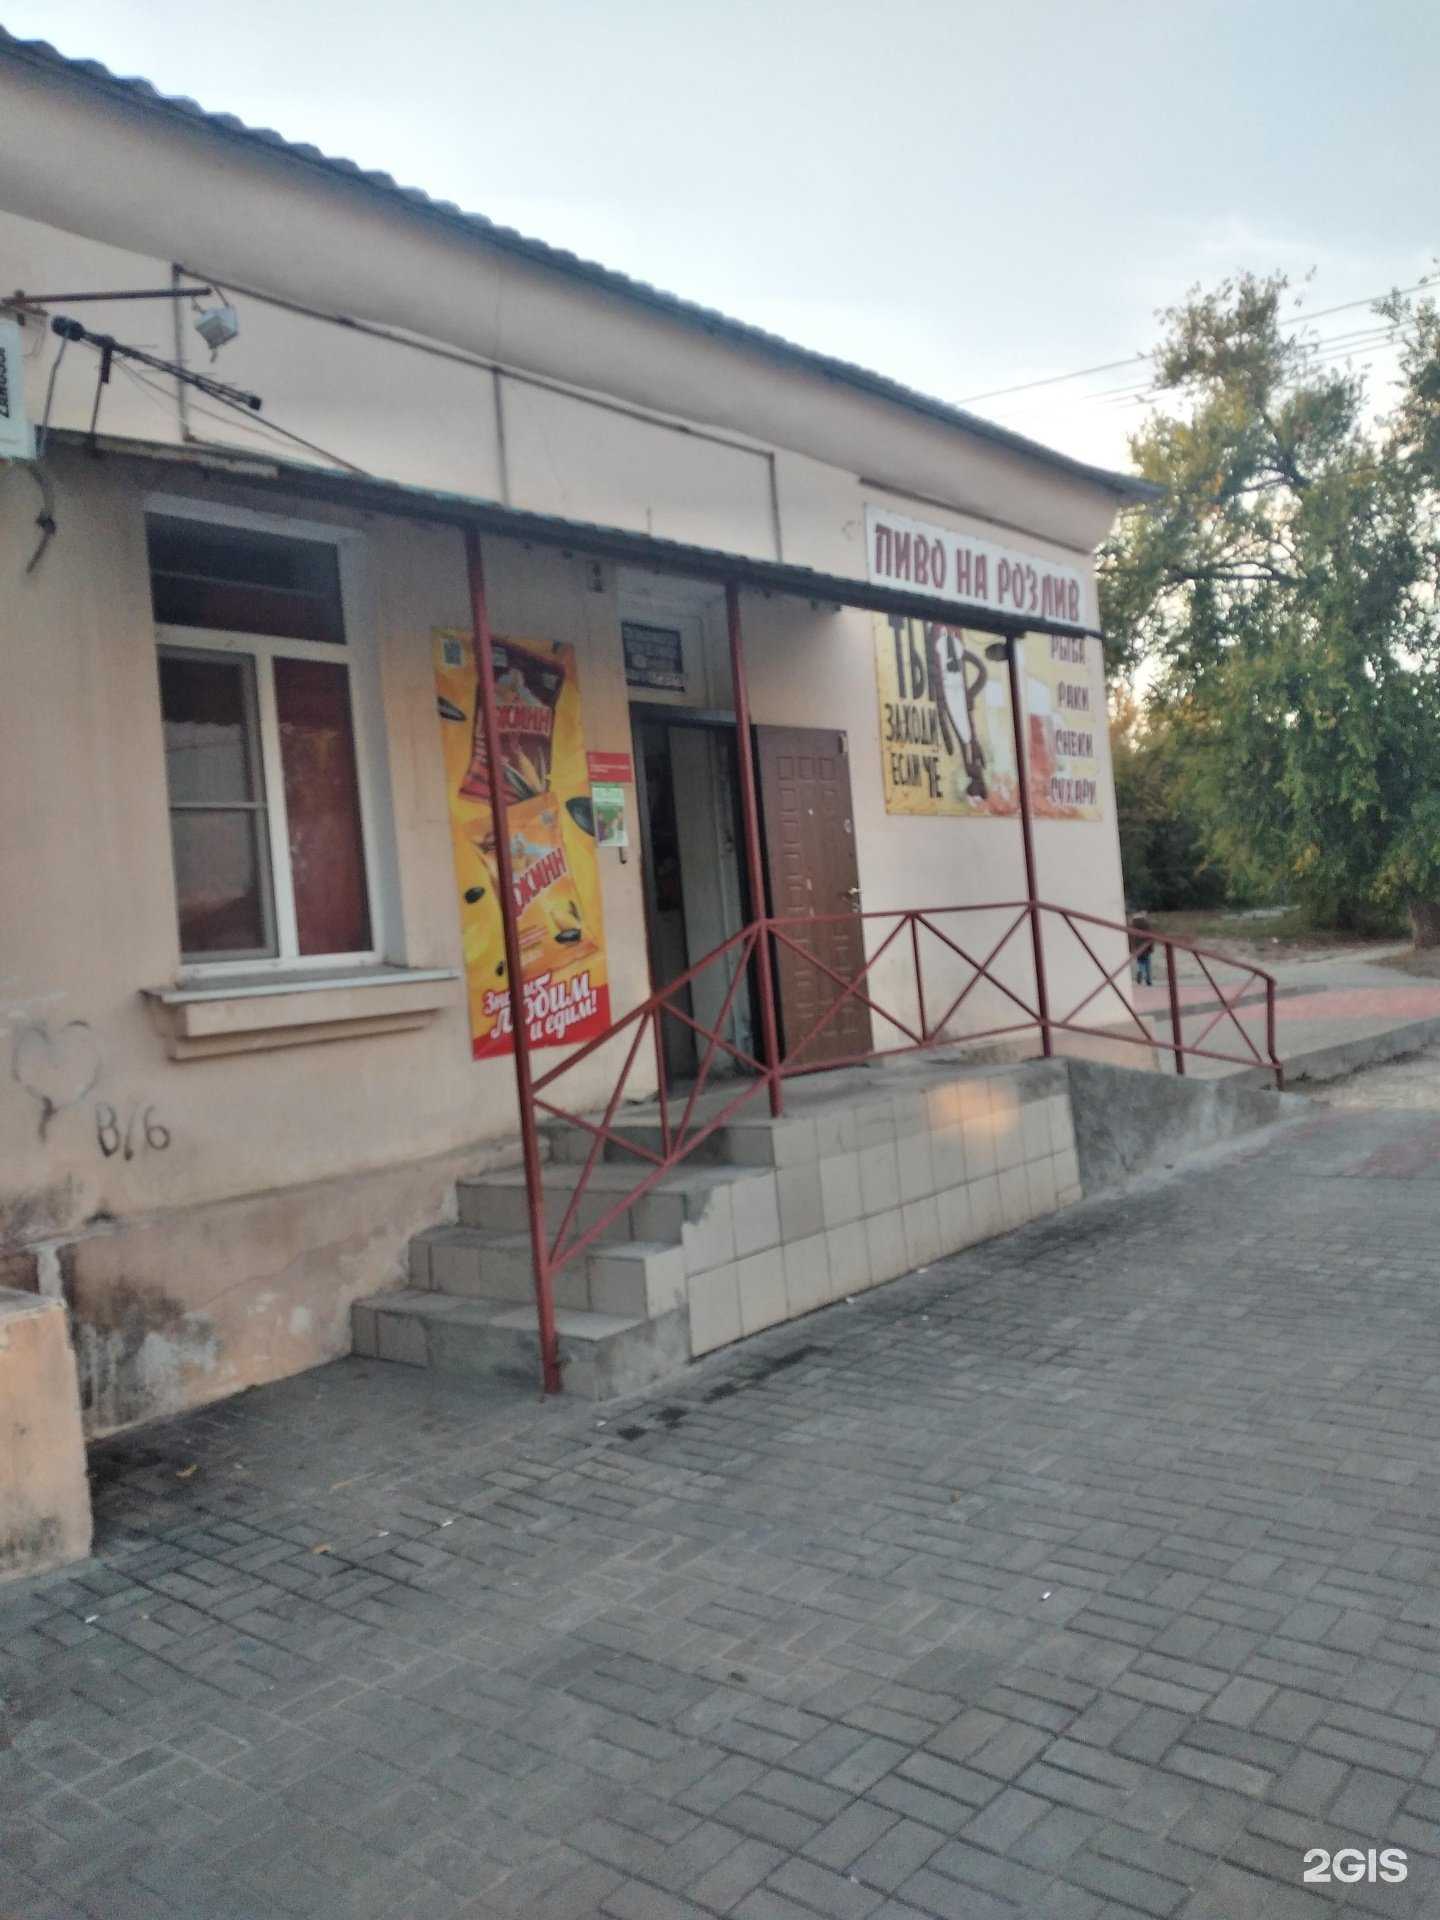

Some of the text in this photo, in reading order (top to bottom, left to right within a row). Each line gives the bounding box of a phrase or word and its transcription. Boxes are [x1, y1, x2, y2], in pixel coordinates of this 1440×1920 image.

[875, 523, 1080, 622] ПИВО НА РОЗЛИВ
[1057, 680, 1089, 711] РАКИ
[1055, 728, 1093, 758] СНЕКИ
